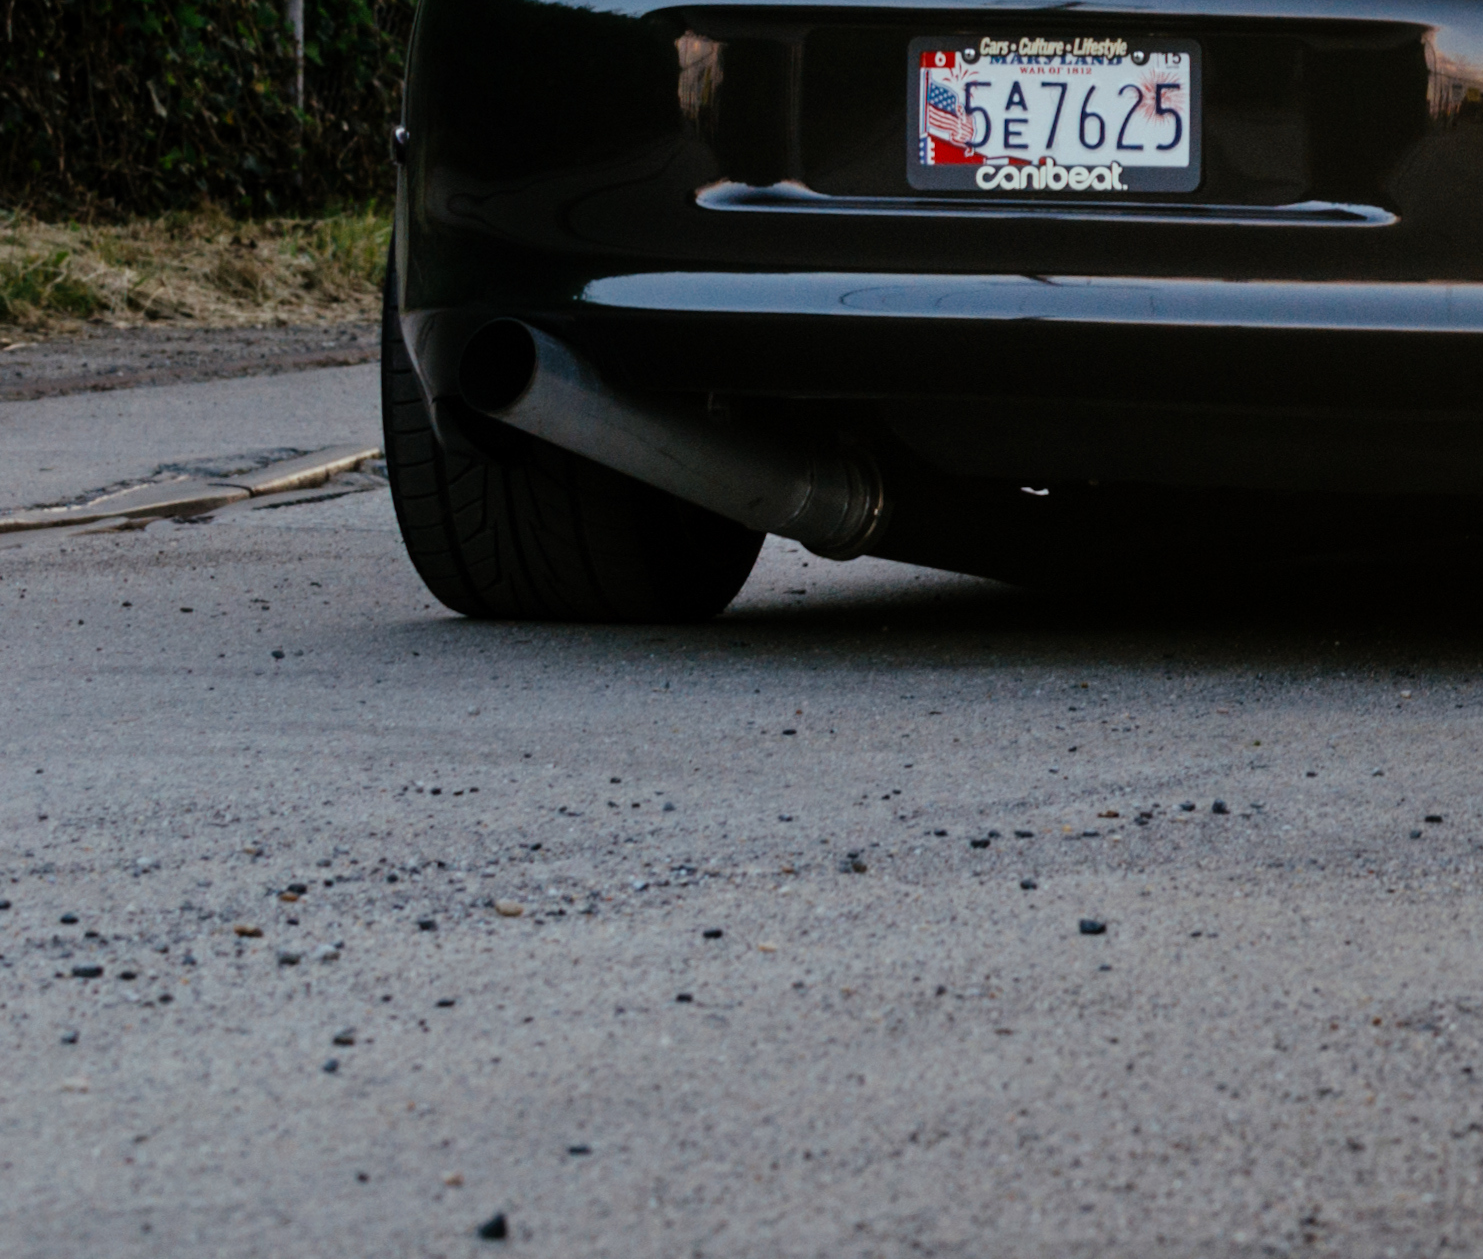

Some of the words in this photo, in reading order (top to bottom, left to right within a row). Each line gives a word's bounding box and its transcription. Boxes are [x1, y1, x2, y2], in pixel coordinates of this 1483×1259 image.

[980, 37, 1009, 55] Cars
[1019, 37, 1064, 55] Culture
[1073, 37, 1127, 59] Lifestyle
[934, 51, 946, 66] 6
[1020, 67, 1045, 75] WAR
[1049, 67, 1063, 75] OF
[1067, 67, 1092, 75] 1812
